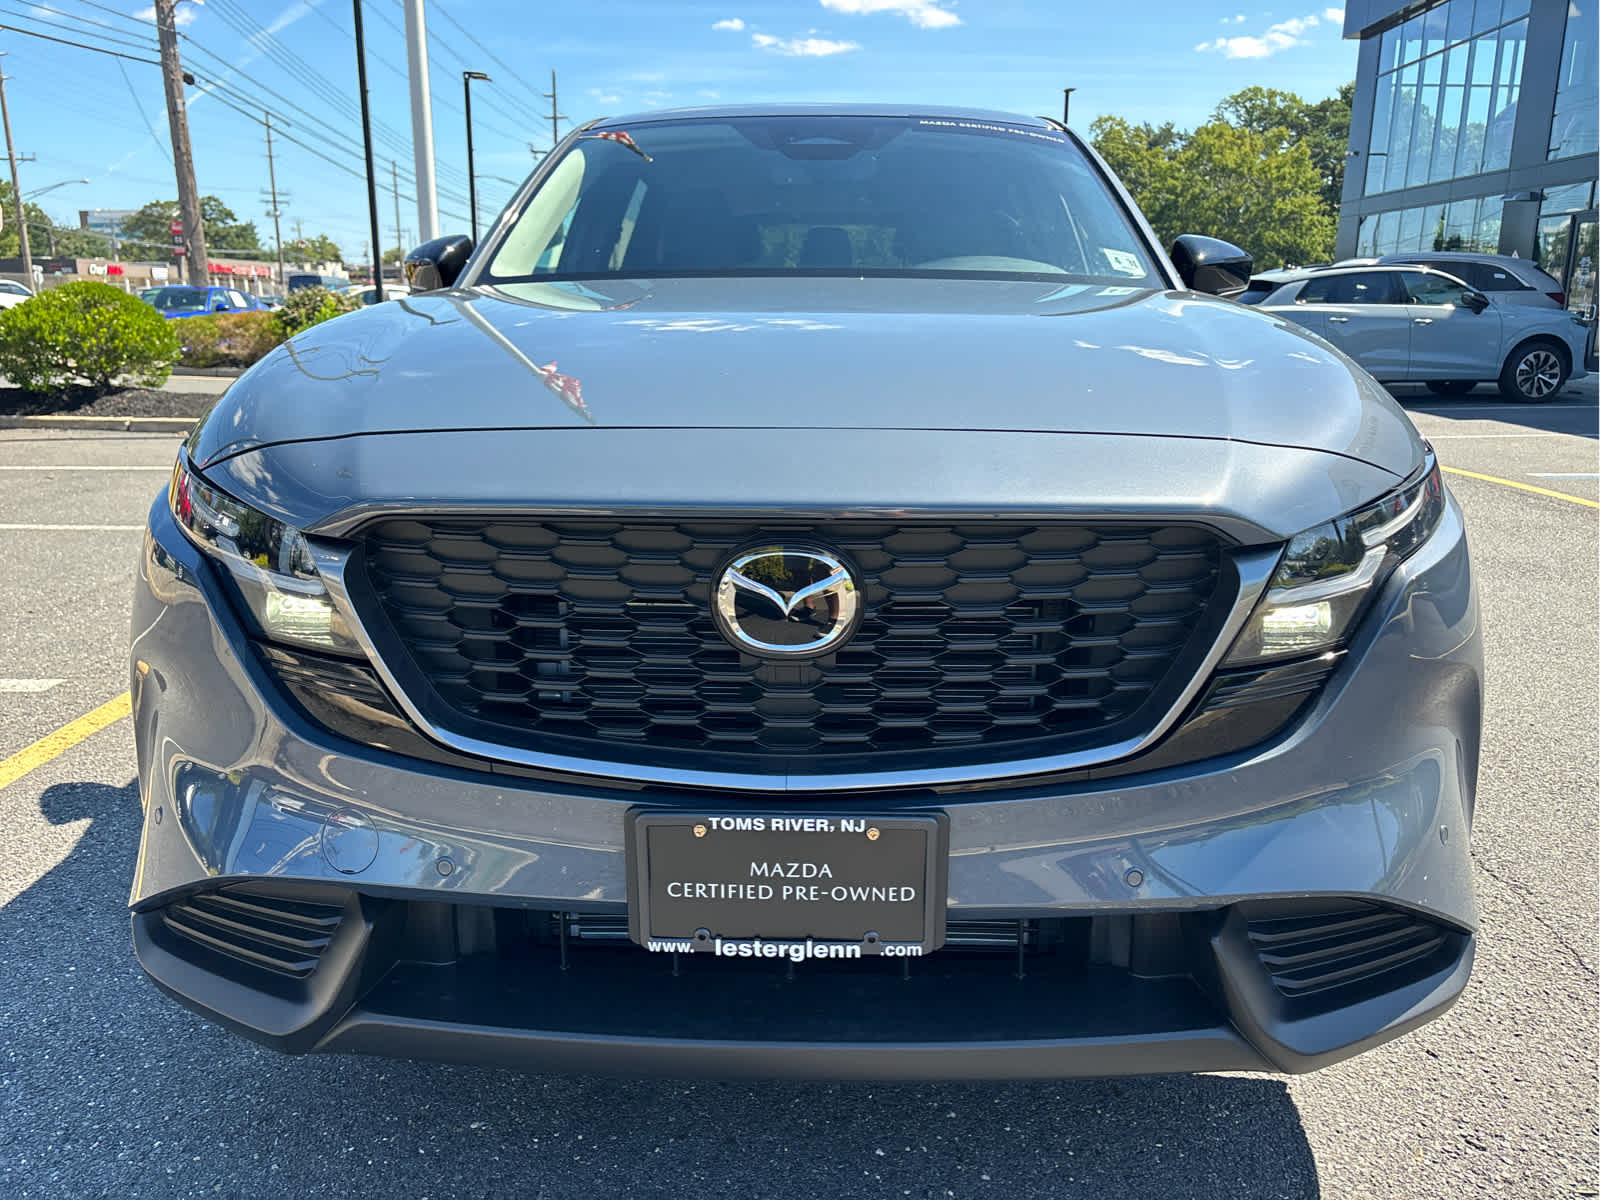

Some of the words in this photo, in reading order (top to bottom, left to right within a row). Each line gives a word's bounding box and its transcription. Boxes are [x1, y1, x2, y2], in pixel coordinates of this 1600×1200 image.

[708, 817, 765, 832] TOMS
[771, 818, 836, 833] RIVER,
[840, 819, 866, 833] NJ
[749, 861, 833, 879] MAZDA
[667, 882, 774, 900] CERTIFIED
[782, 885, 916, 902] PRE-OWNED
[648, 941, 695, 954] www.
[714, 938, 861, 962] lesterglenn
[879, 943, 923, 957] .com
